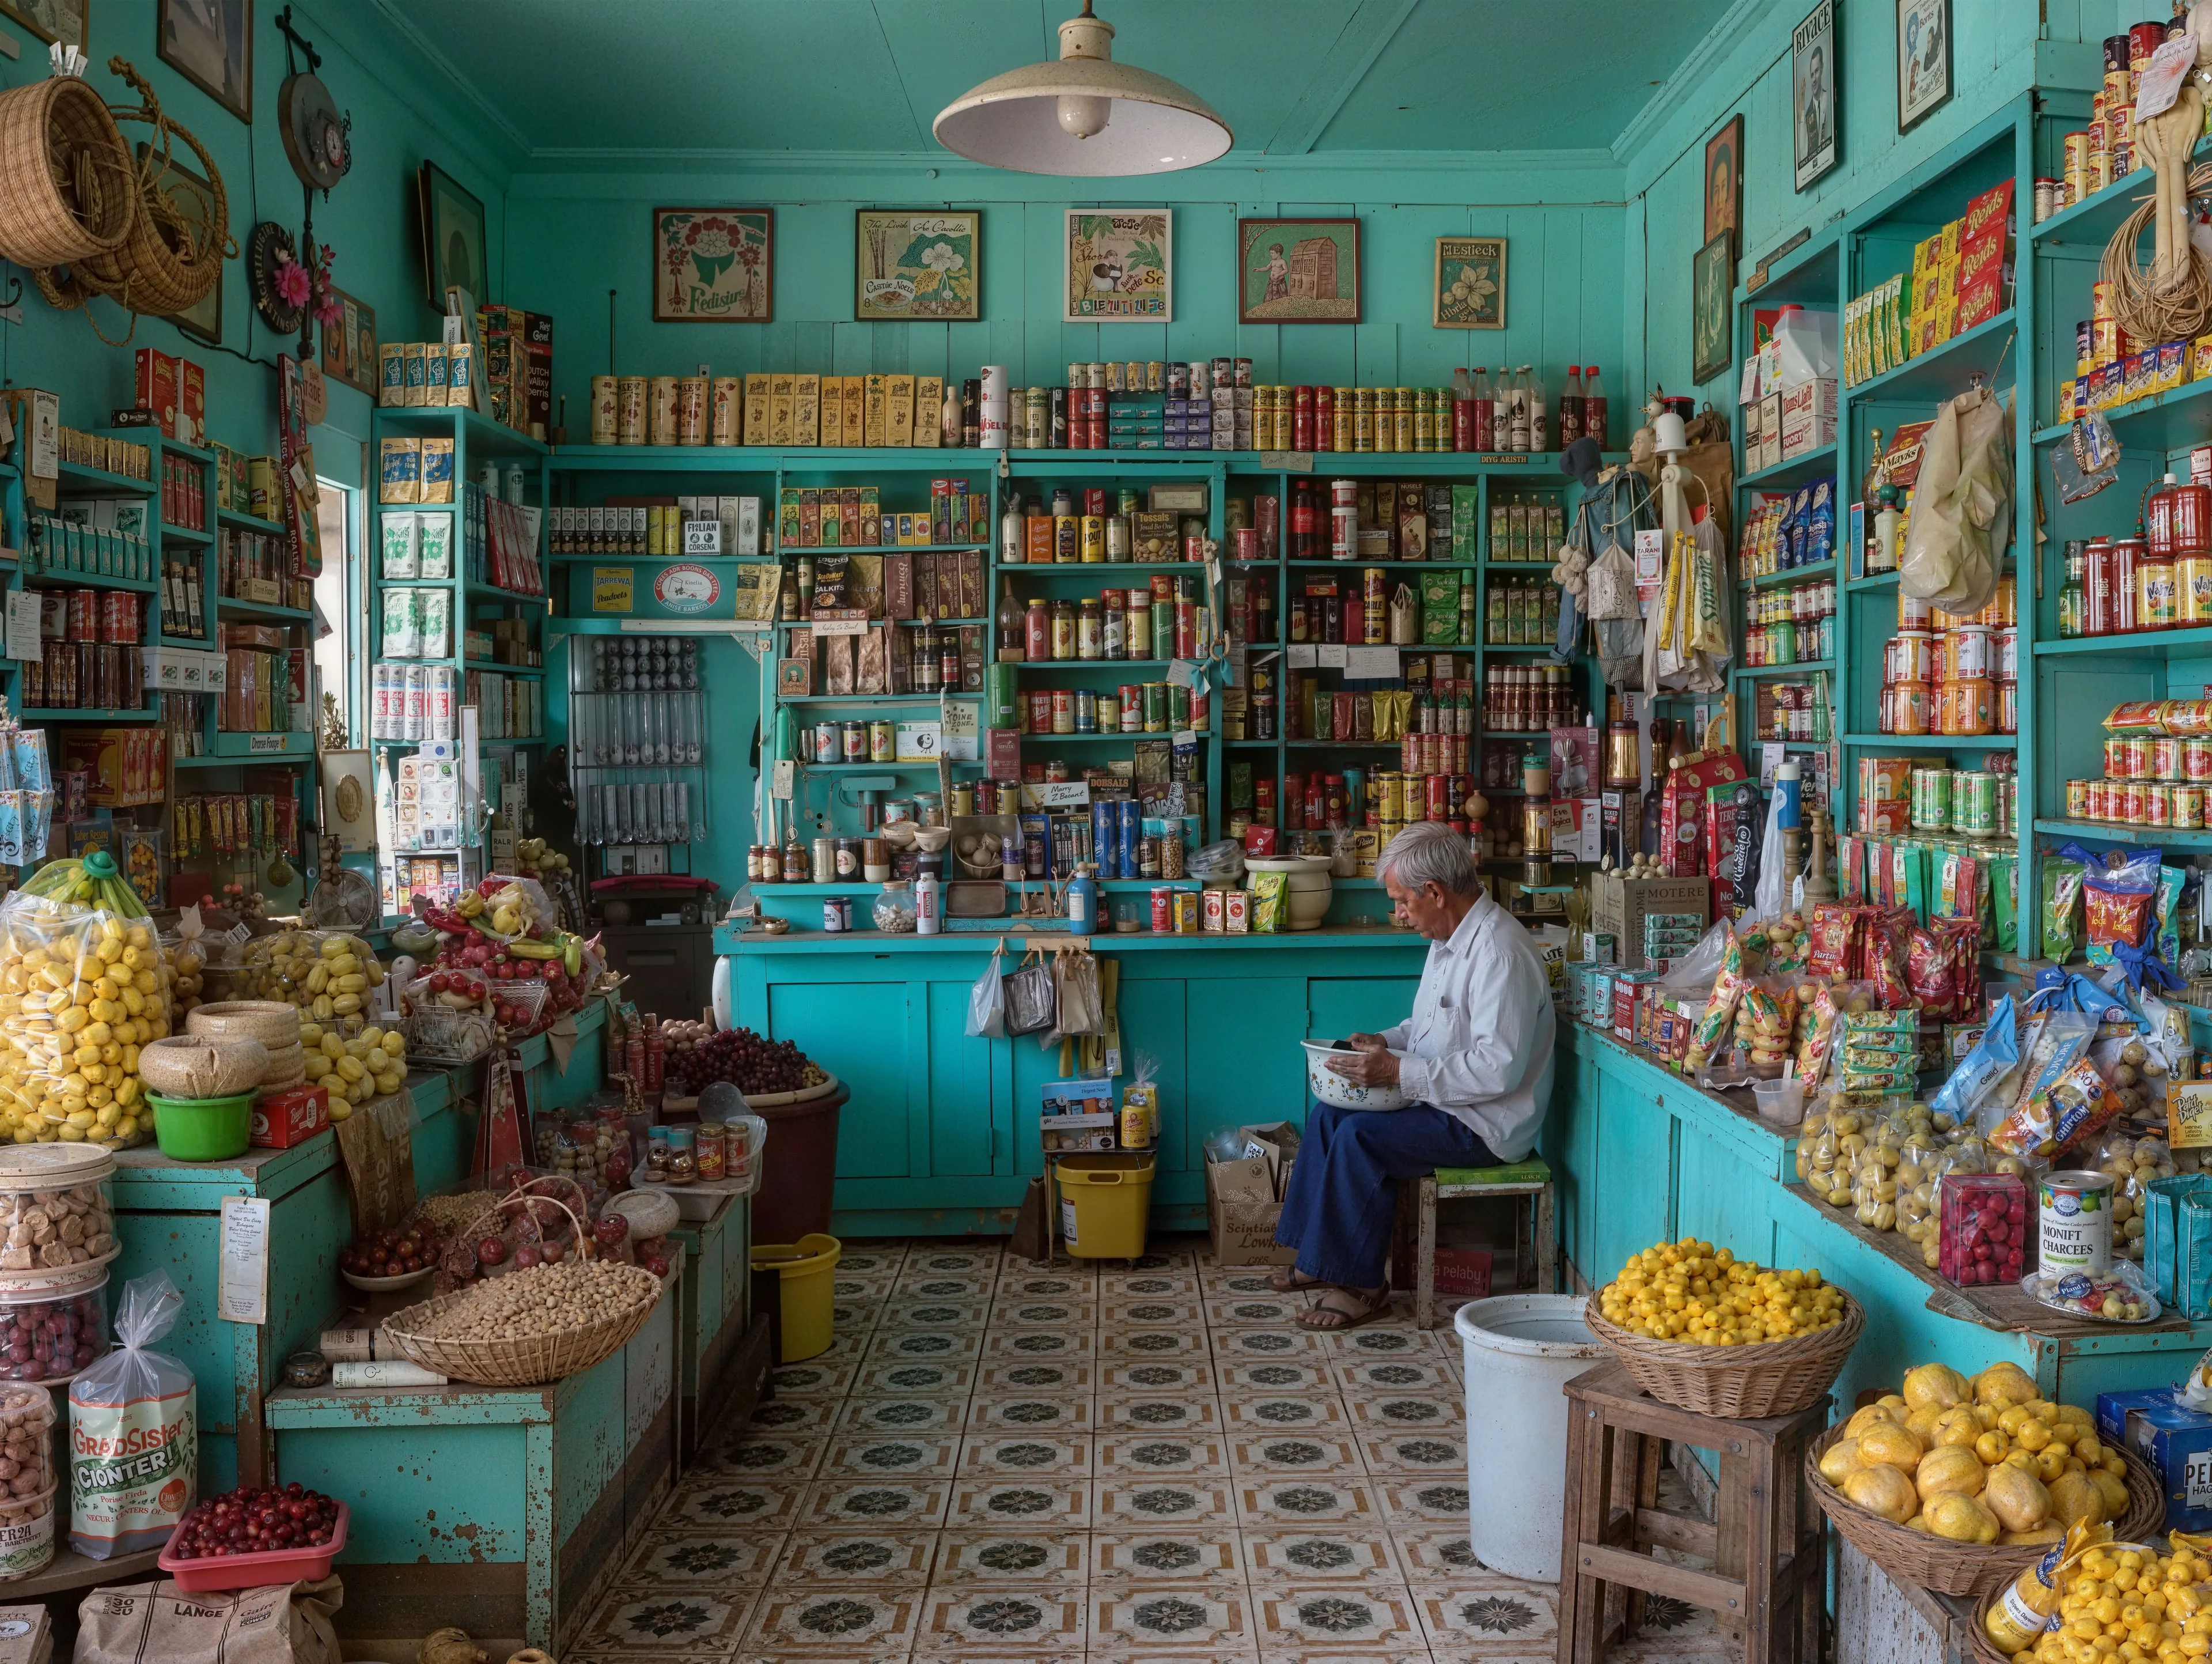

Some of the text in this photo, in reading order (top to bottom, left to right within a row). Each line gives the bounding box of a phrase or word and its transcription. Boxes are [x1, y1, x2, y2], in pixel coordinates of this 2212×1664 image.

[1139, 513, 1169, 522] Tossals
[1090, 779, 1128, 787] DOBSALS
[1647, 886, 1705, 899] MOTERE
[2043, 1225, 2082, 1241] MONIFT
[2043, 1239, 2093, 1255] CHARCEES
[2080, 1282, 2091, 1290] Fit
[125, 1489, 147, 1499] Firda
[116, 1507, 149, 1521] CENTERS
[174, 1602, 224, 1618] LANGE
